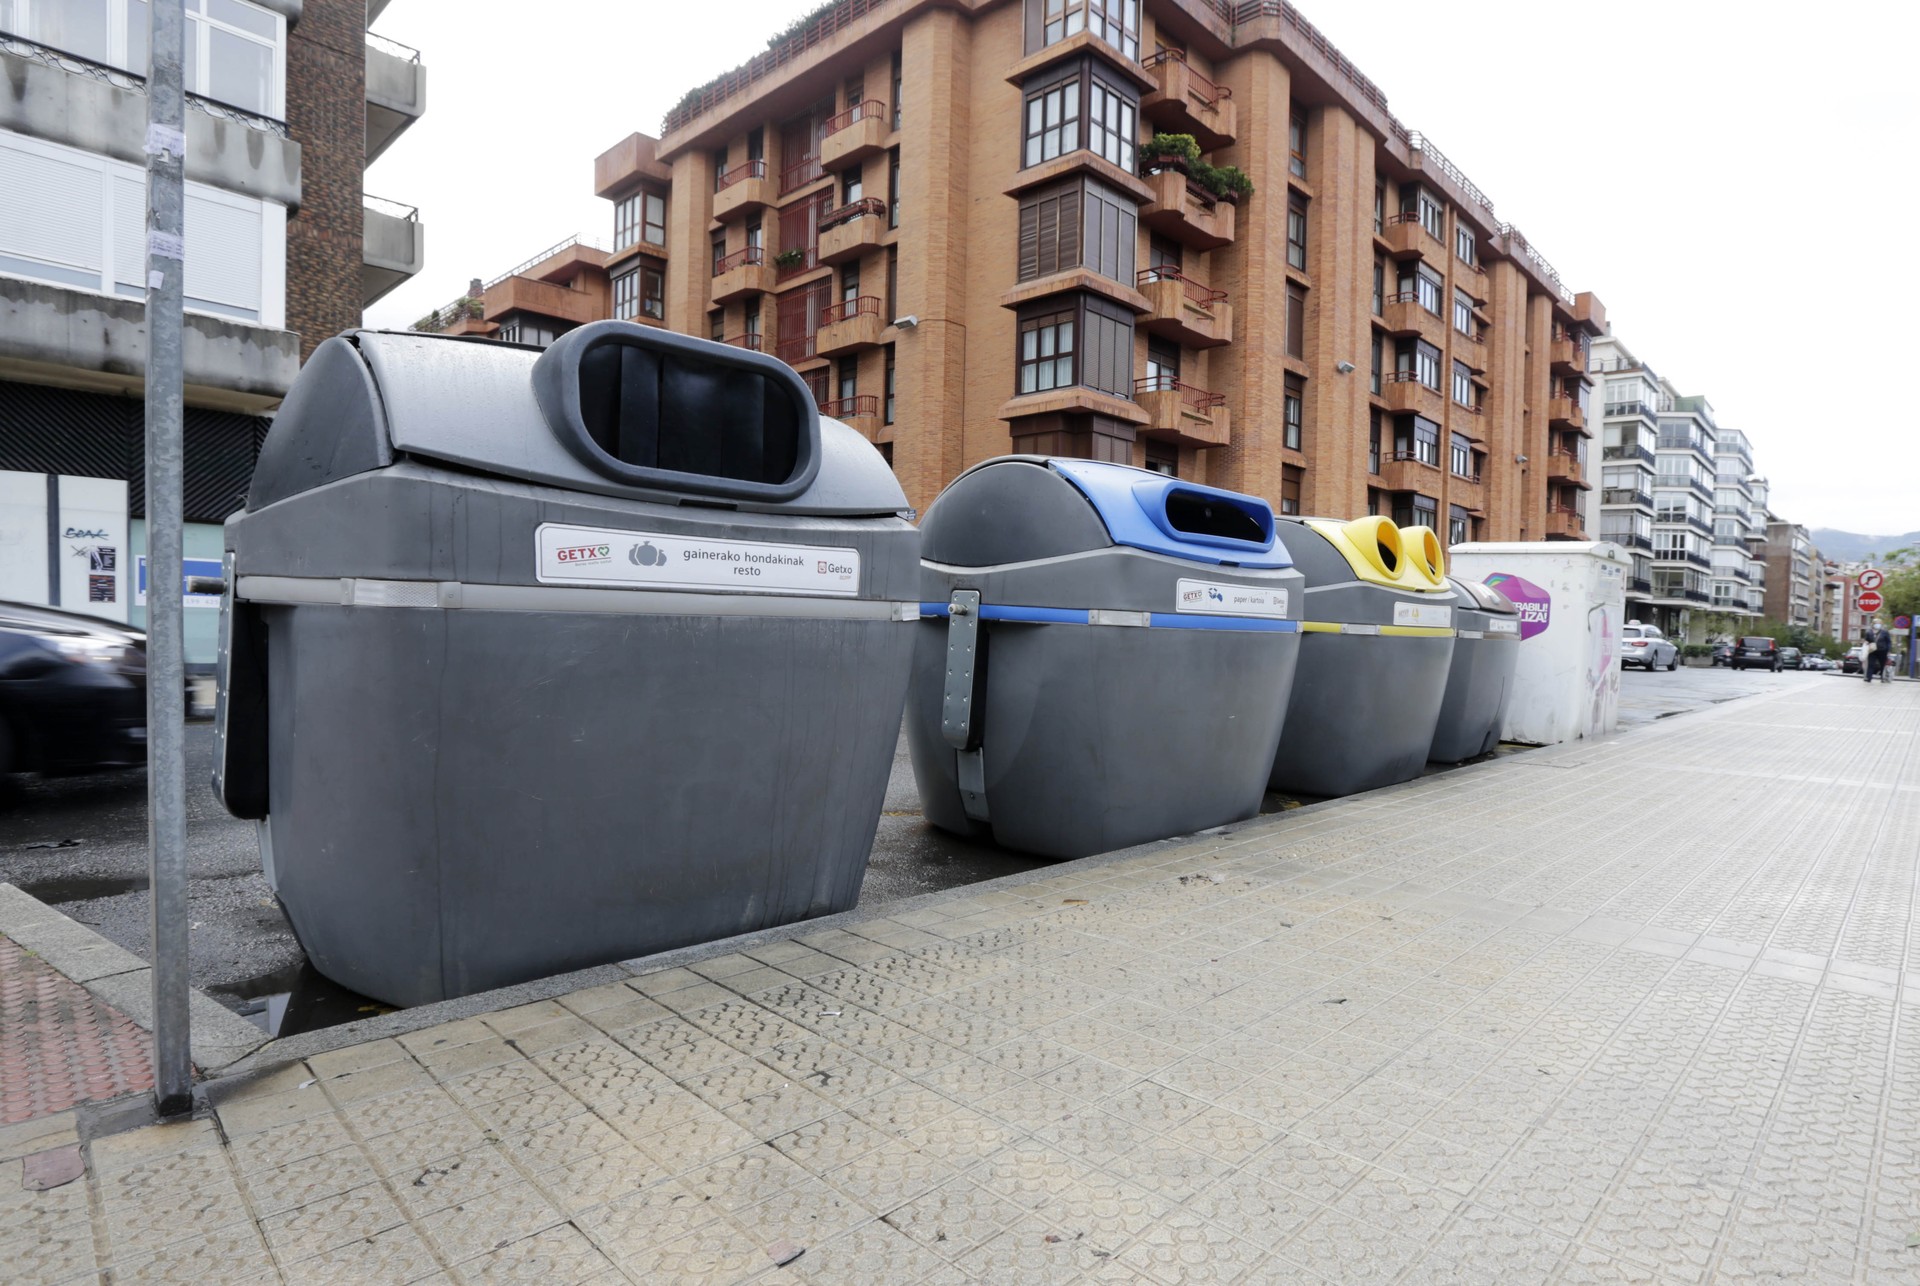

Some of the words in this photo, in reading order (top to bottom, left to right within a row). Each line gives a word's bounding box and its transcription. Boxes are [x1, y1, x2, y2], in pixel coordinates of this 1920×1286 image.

[683, 549, 741, 562] gainerako
[744, 552, 804, 566] hondakinak
[733, 566, 761, 576] resto
[828, 563, 853, 575] Getxo
[1511, 602, 1549, 612] RABILI!
